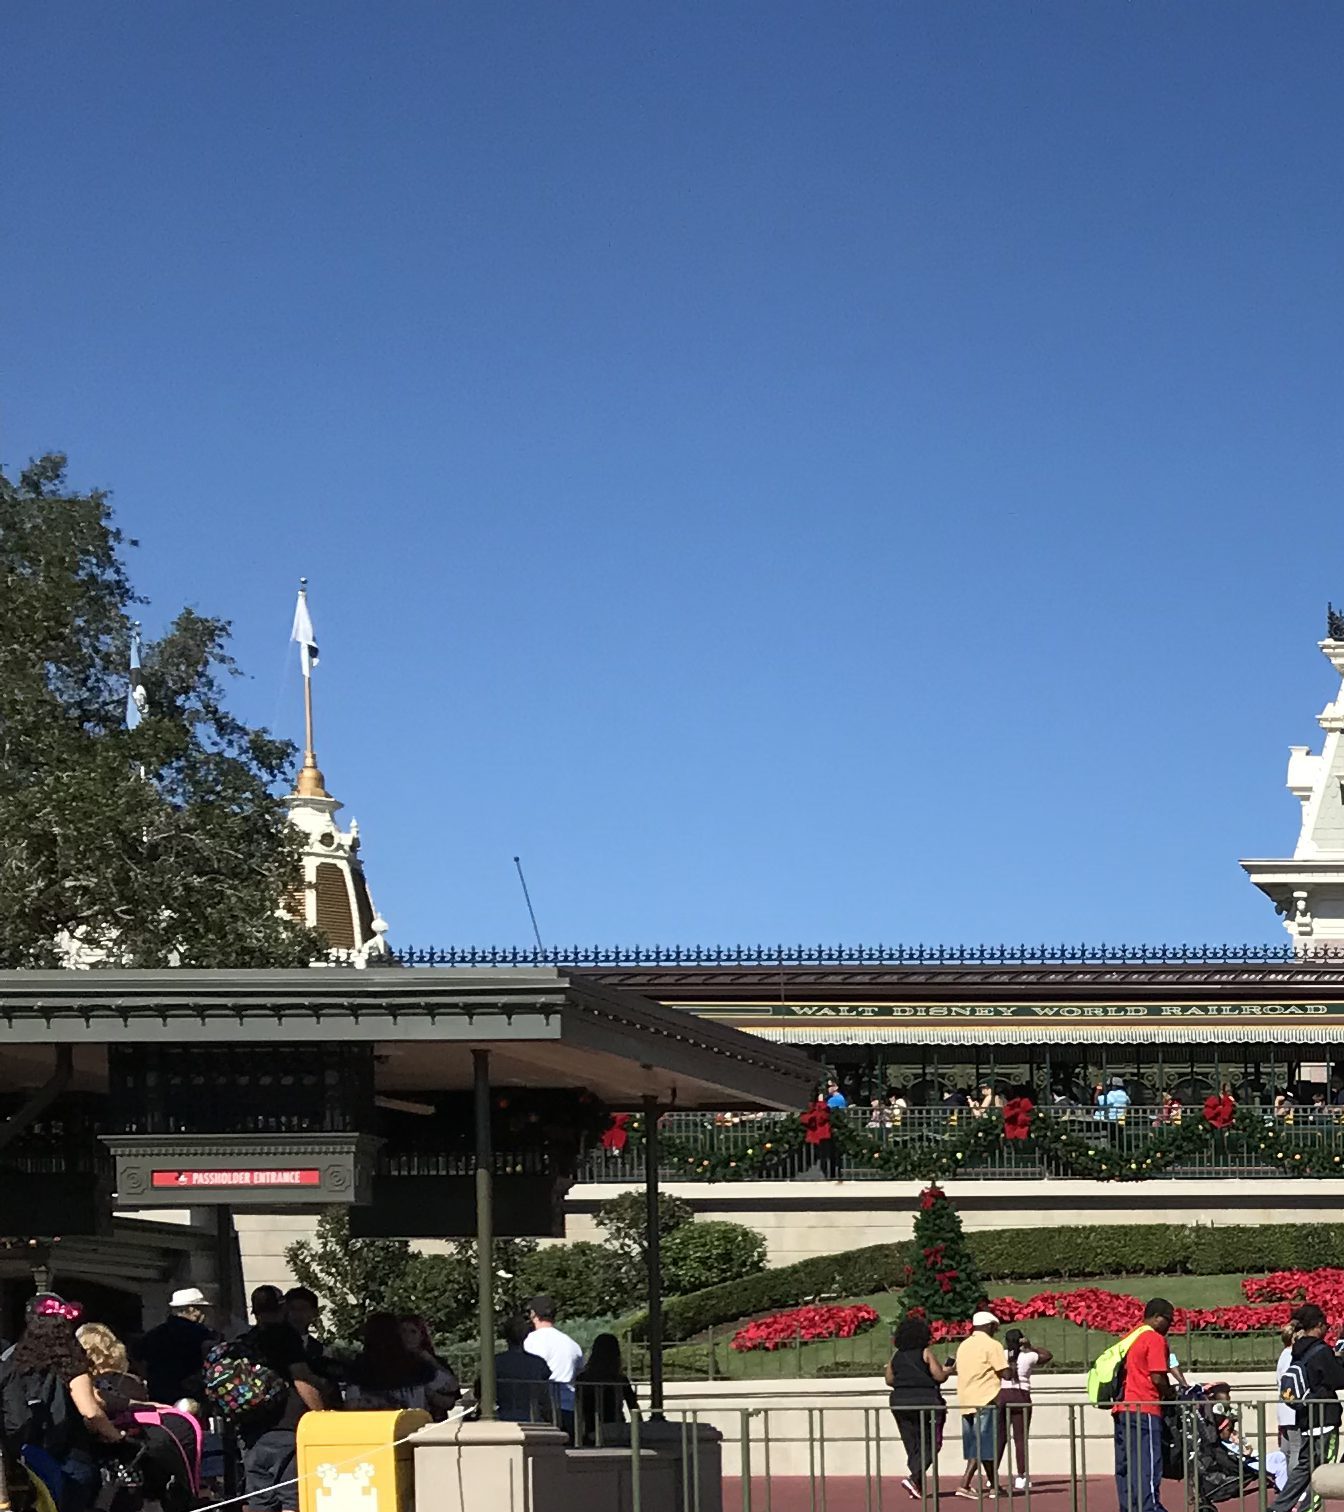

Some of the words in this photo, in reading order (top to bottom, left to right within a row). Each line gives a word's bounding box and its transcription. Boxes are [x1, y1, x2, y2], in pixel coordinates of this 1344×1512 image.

[791, 1006, 878, 1016] WALT
[892, 1006, 1017, 1016] DISNEY
[1031, 1006, 1148, 1016] WORLD
[1161, 1005, 1327, 1015] RAILROAD
[192, 1172, 250, 1184] PASSHOLDER
[253, 1171, 301, 1184] ENTRANCE
